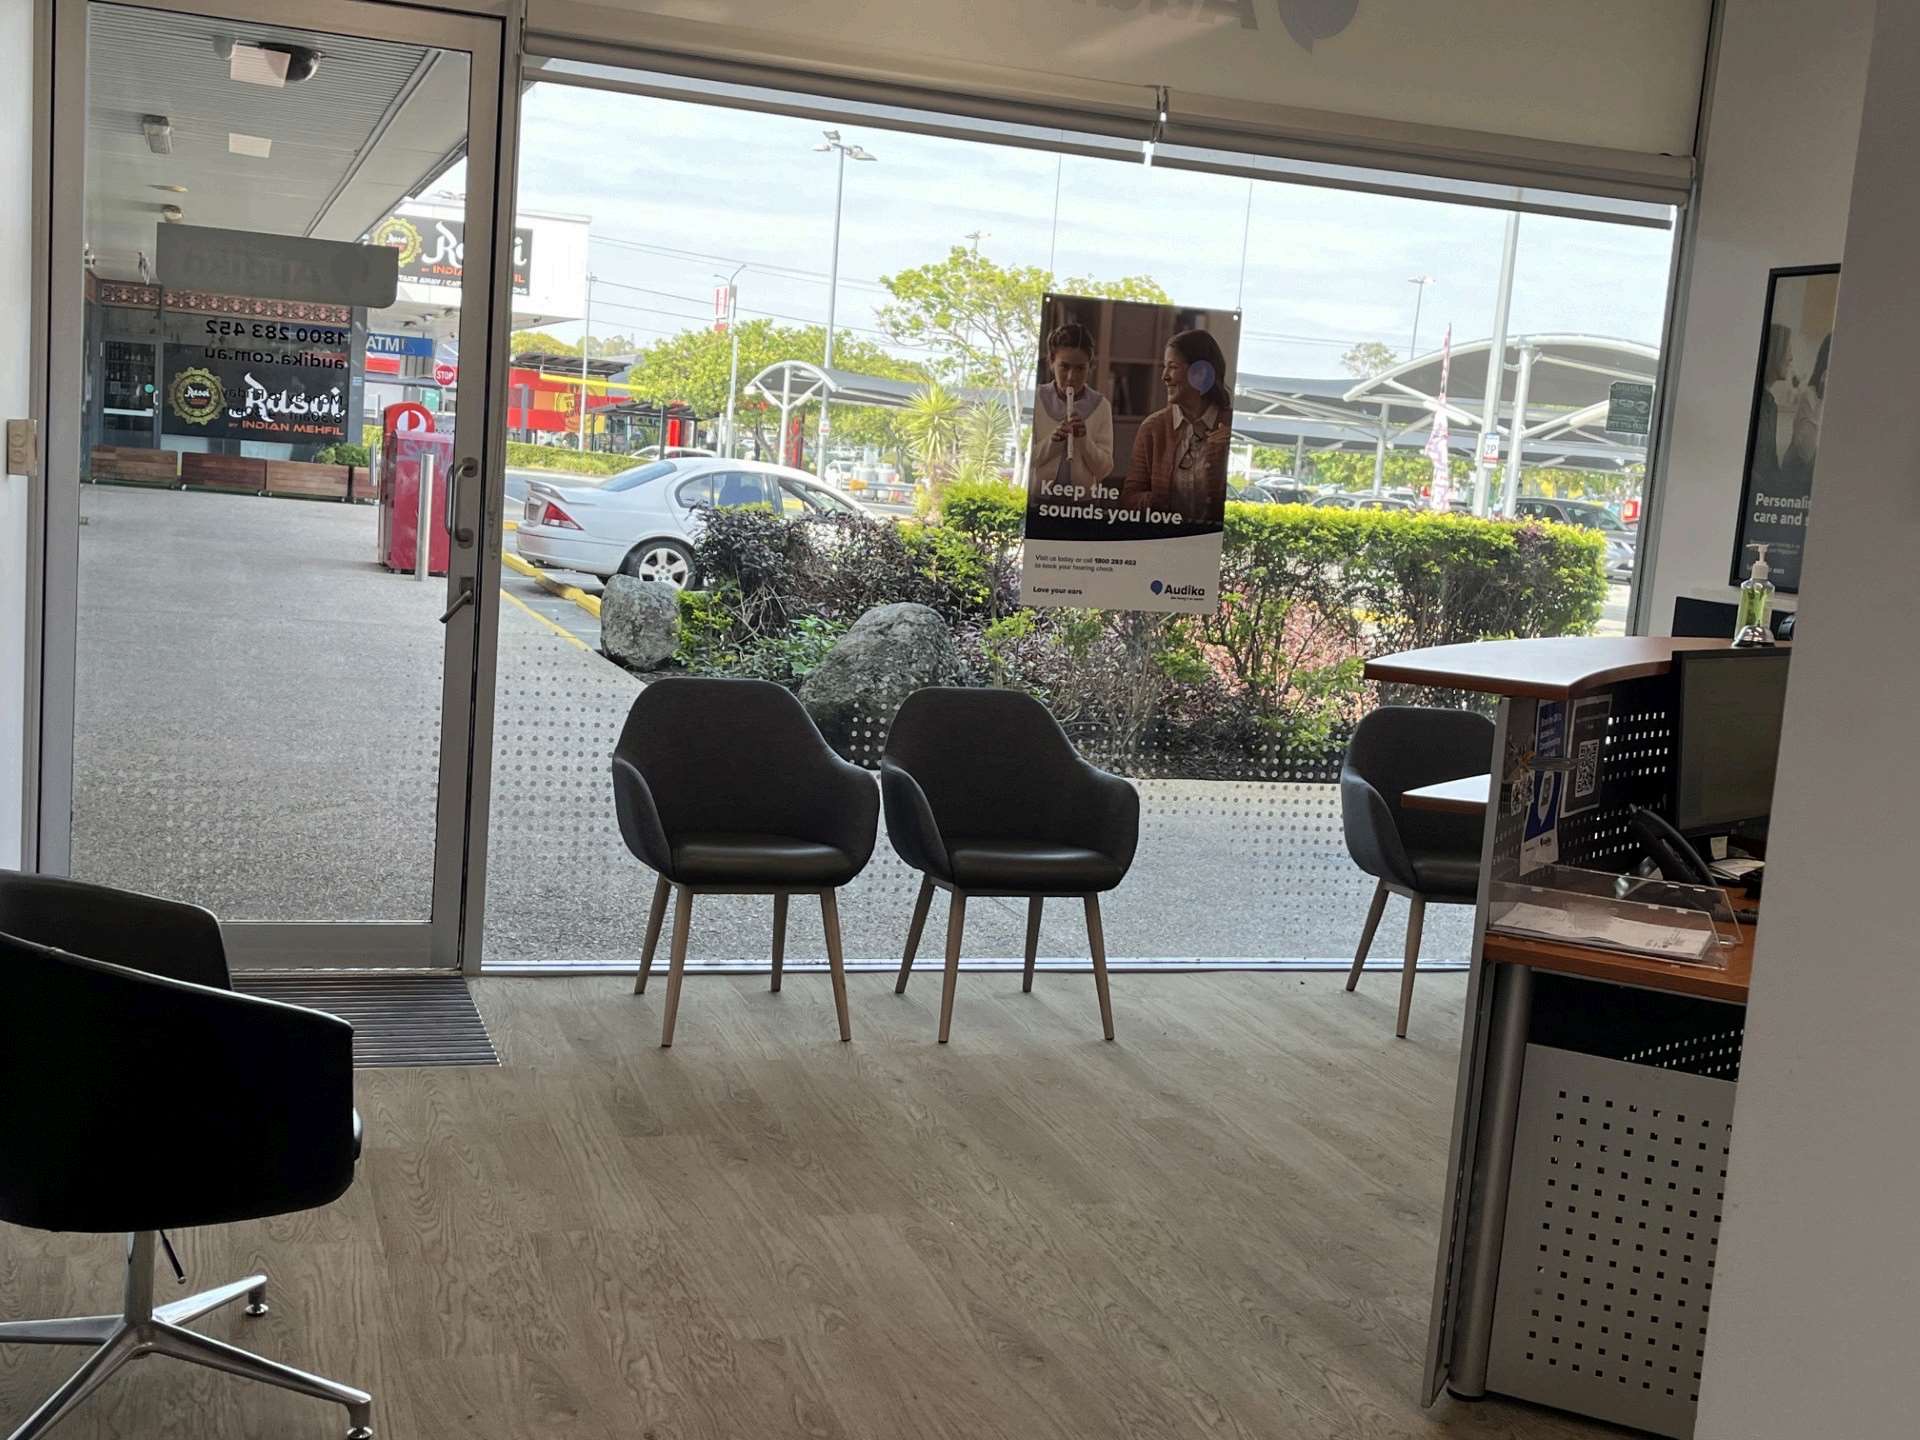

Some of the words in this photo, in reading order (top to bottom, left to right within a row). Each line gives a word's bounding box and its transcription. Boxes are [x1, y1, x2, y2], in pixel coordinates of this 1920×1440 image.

[366, 335, 400, 352] ATM
[436, 371, 453, 380] STOP
[242, 421, 290, 431] INDIAN
[293, 424, 345, 436] MEHFIL
[1040, 479, 1085, 500] Keep
[1090, 483, 1120, 500] the
[1755, 493, 1809, 509] Personali
[1038, 503, 1103, 520] sounds
[1107, 508, 1140, 524] you
[1145, 507, 1183, 525] love
[1753, 512, 1777, 524] care
[1780, 512, 1803, 526] and
[1164, 584, 1205, 596] Audika
